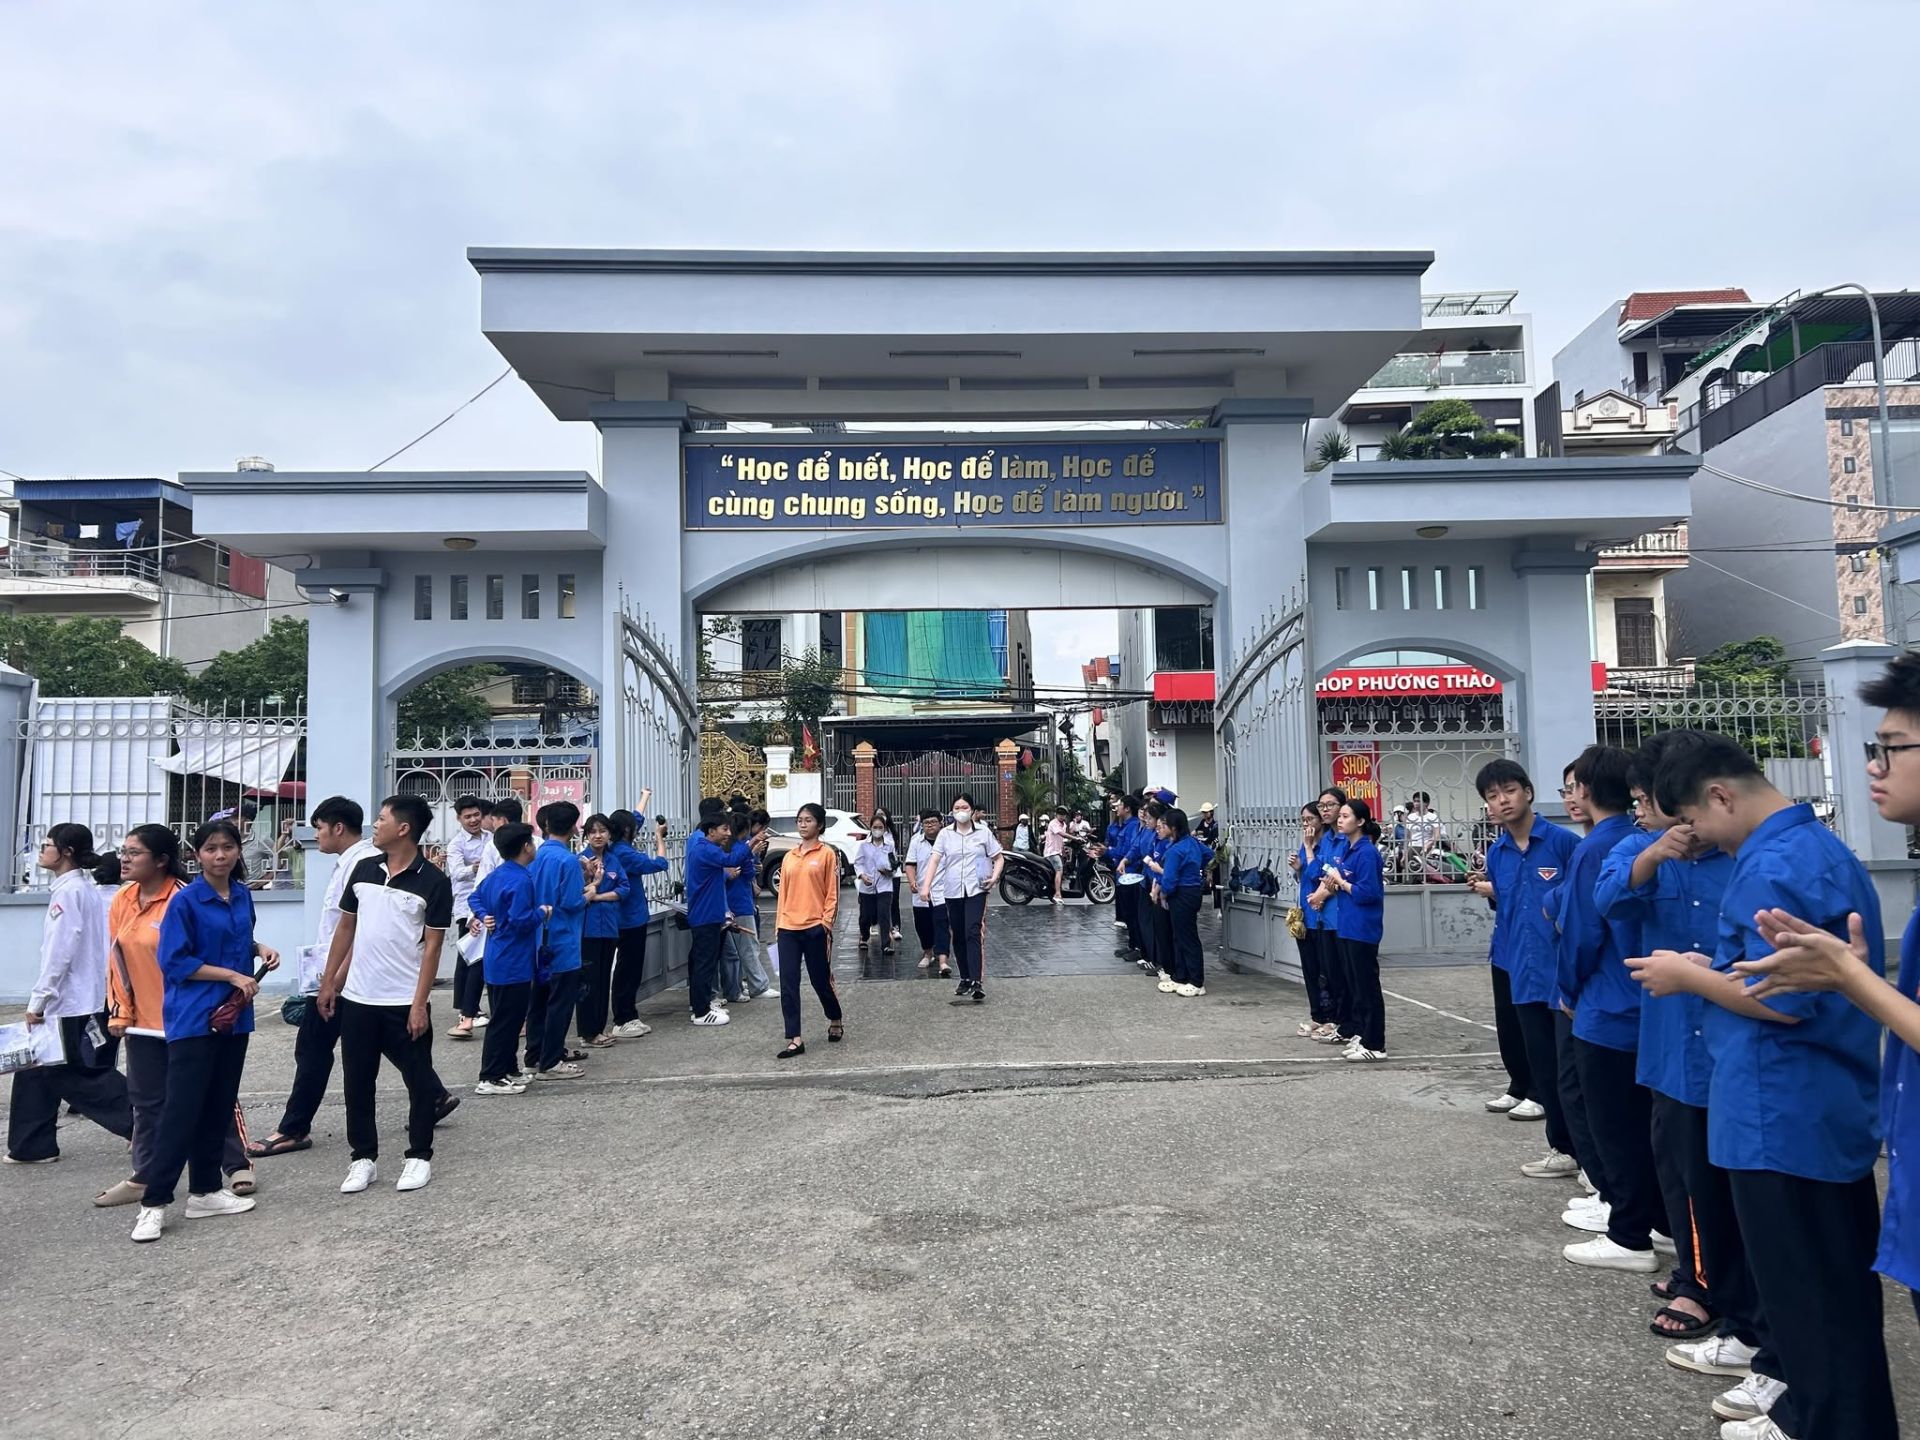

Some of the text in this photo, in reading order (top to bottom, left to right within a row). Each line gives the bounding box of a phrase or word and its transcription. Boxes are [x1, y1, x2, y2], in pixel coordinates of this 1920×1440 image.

[797, 451, 832, 481] để
[839, 452, 897, 483] biết,
[903, 457, 952, 485] Học
[961, 449, 995, 480] để
[1001, 454, 1057, 482] làm,
[1063, 455, 1112, 483] Học
[1123, 447, 1157, 477] để
[708, 490, 775, 520] cùng
[783, 492, 866, 520] chung
[874, 487, 946, 519] sống,
[953, 490, 1004, 518] Học
[1012, 484, 1048, 513] để
[1053, 488, 1102, 513] làm
[1315, 669, 1496, 692] HOP PHƯƠNG THẢO
[1403, 704, 1425, 719] GIA
[1342, 756, 1370, 775] SHOP
